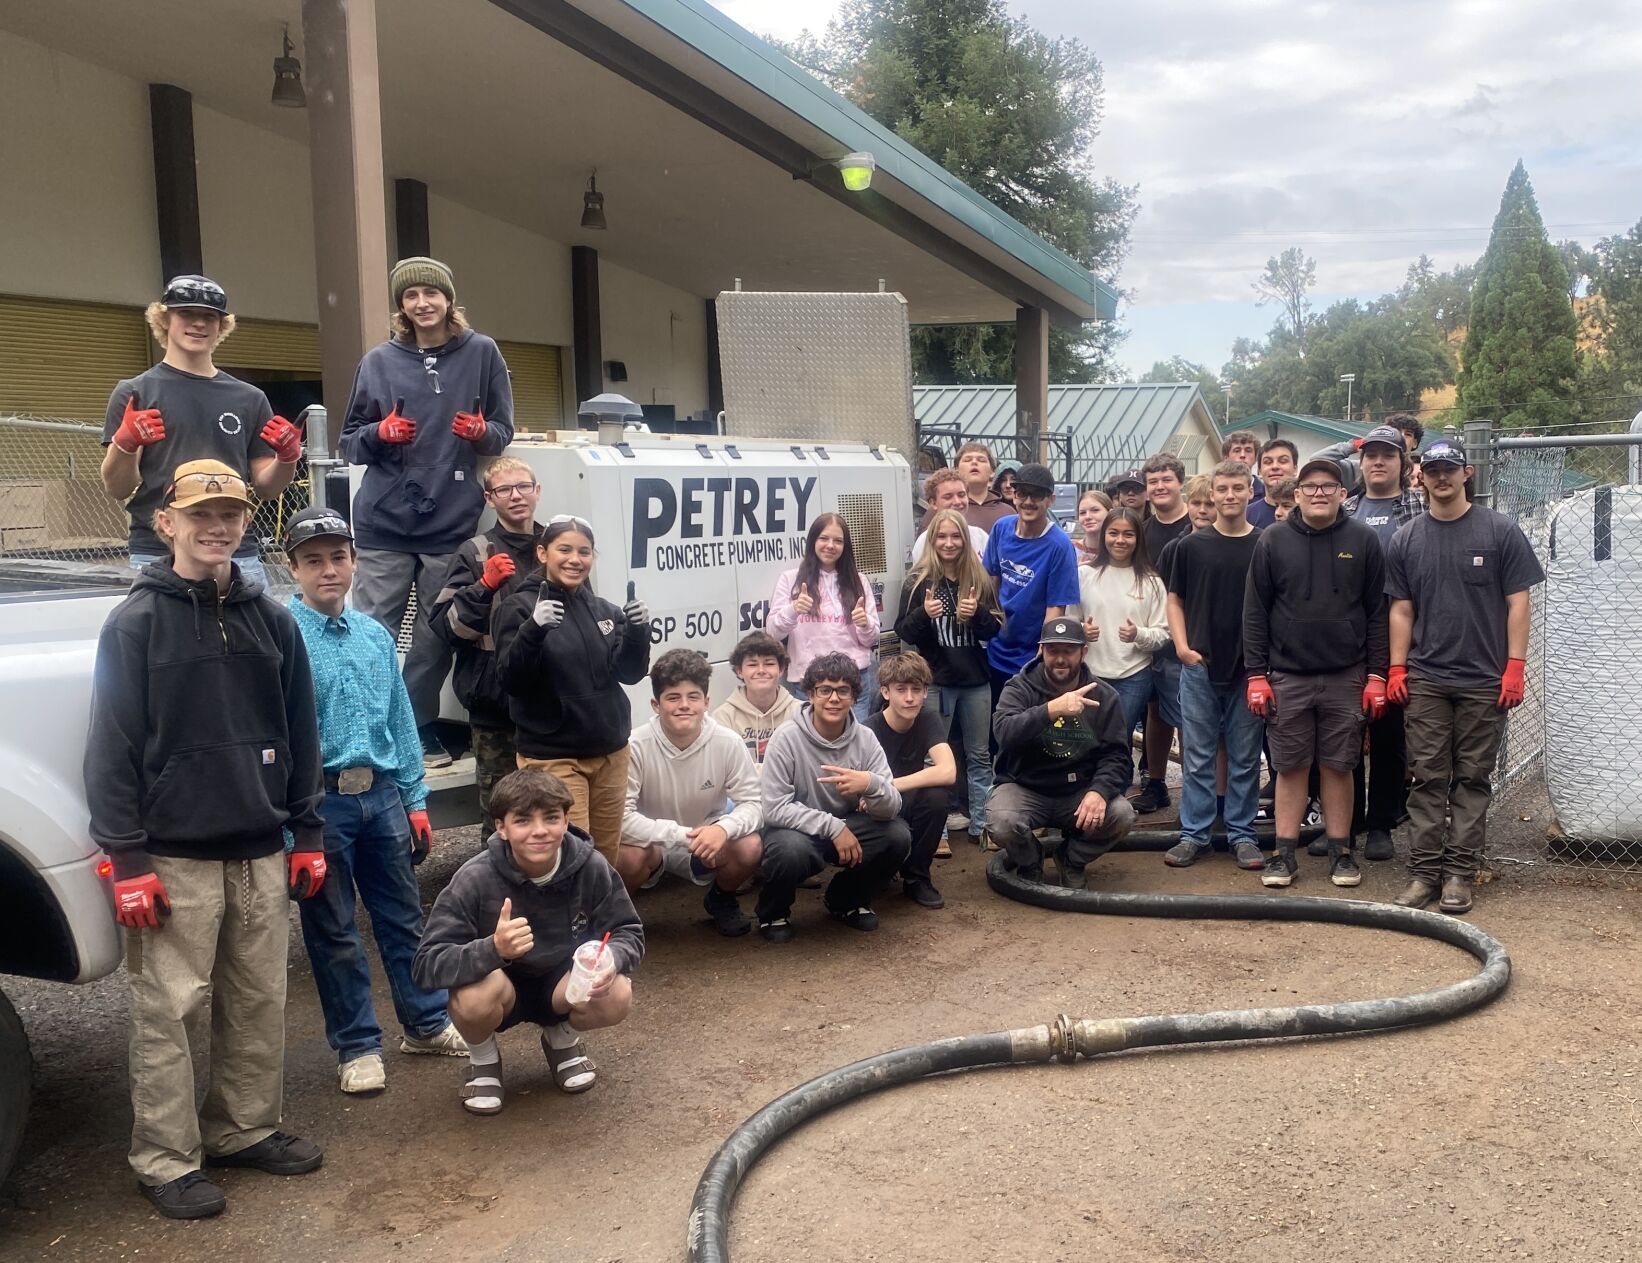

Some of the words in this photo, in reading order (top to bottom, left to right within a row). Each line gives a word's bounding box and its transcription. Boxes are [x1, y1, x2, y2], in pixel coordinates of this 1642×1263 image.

[631, 477, 817, 569] PETREY
[656, 542, 726, 571] CONCRETE
[728, 537, 787, 565] PUMPING,
[650, 616, 676, 644] SP
[685, 610, 722, 639] 500
